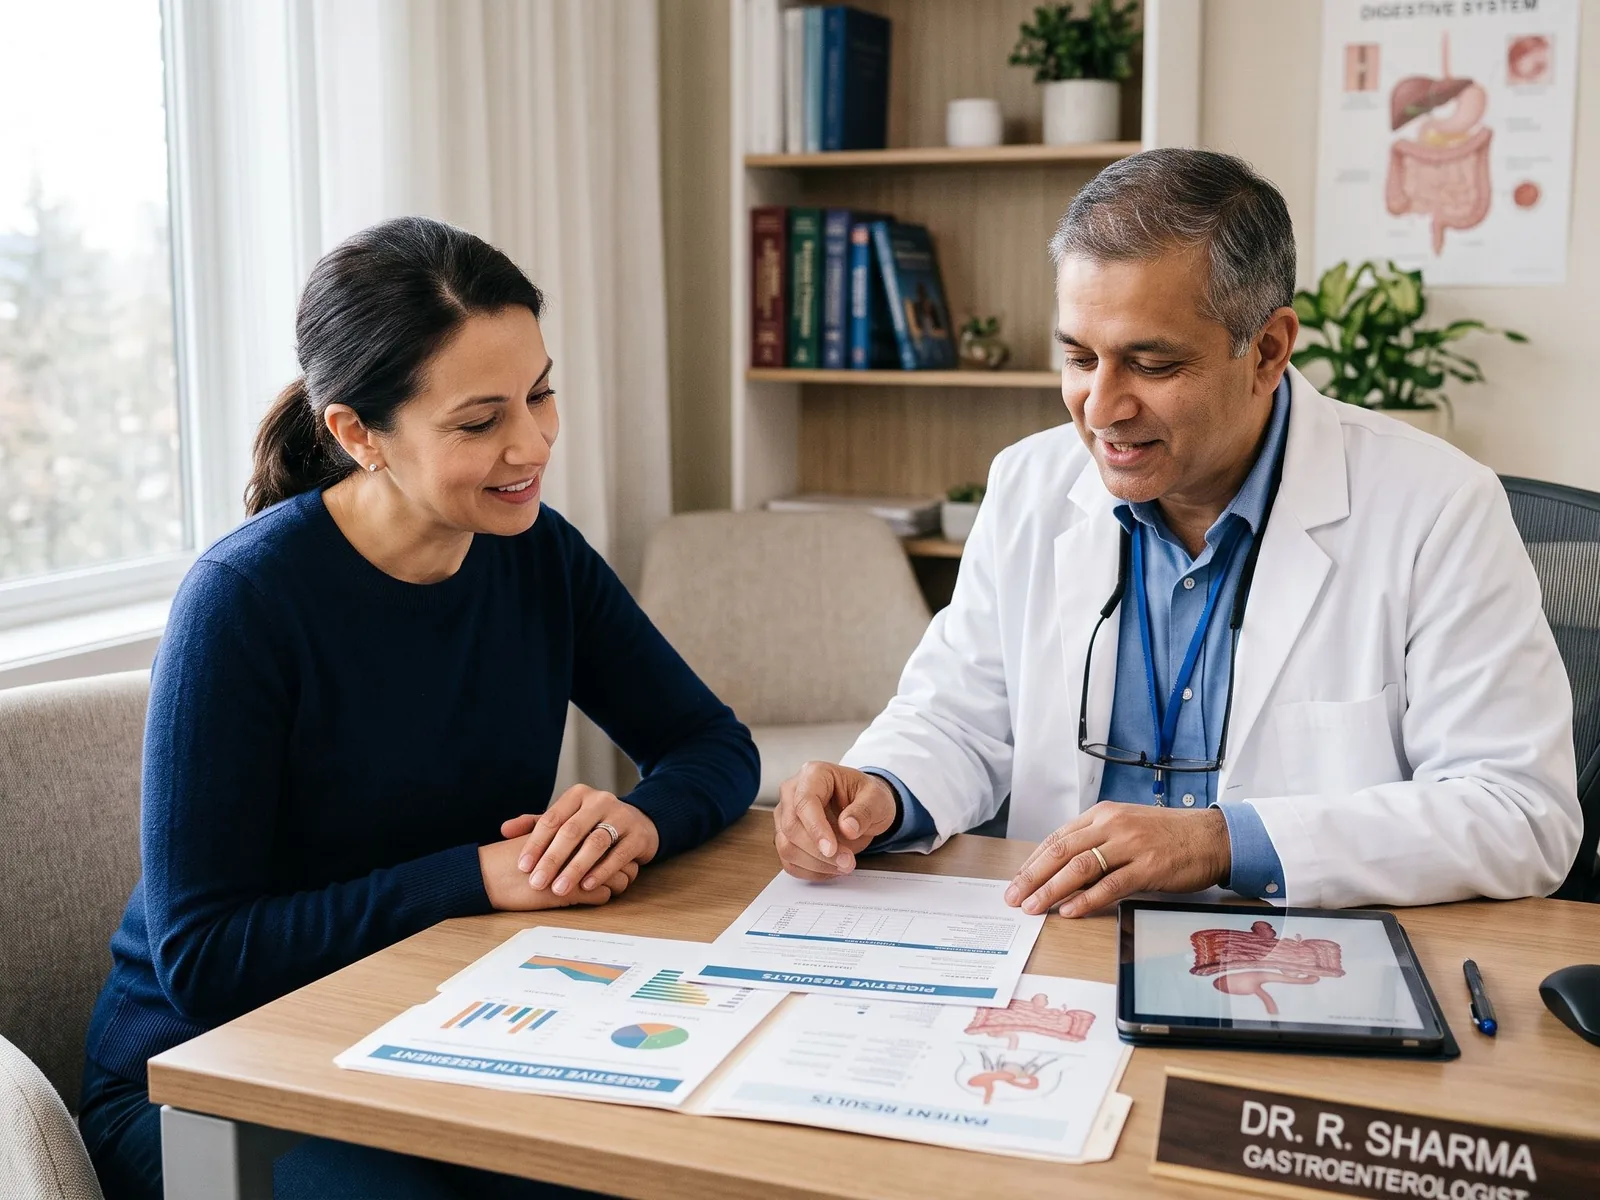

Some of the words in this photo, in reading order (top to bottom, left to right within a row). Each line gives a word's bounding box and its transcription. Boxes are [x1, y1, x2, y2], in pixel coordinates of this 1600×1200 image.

[564, 1070, 661, 1088] DIGESTIVE
[811, 1094, 898, 1113] RESULTS
[905, 1107, 989, 1127] PATIENT
[1240, 1101, 1303, 1143] DR.
[1316, 1112, 1353, 1151] R.
[1365, 1121, 1538, 1182] SHARMA
